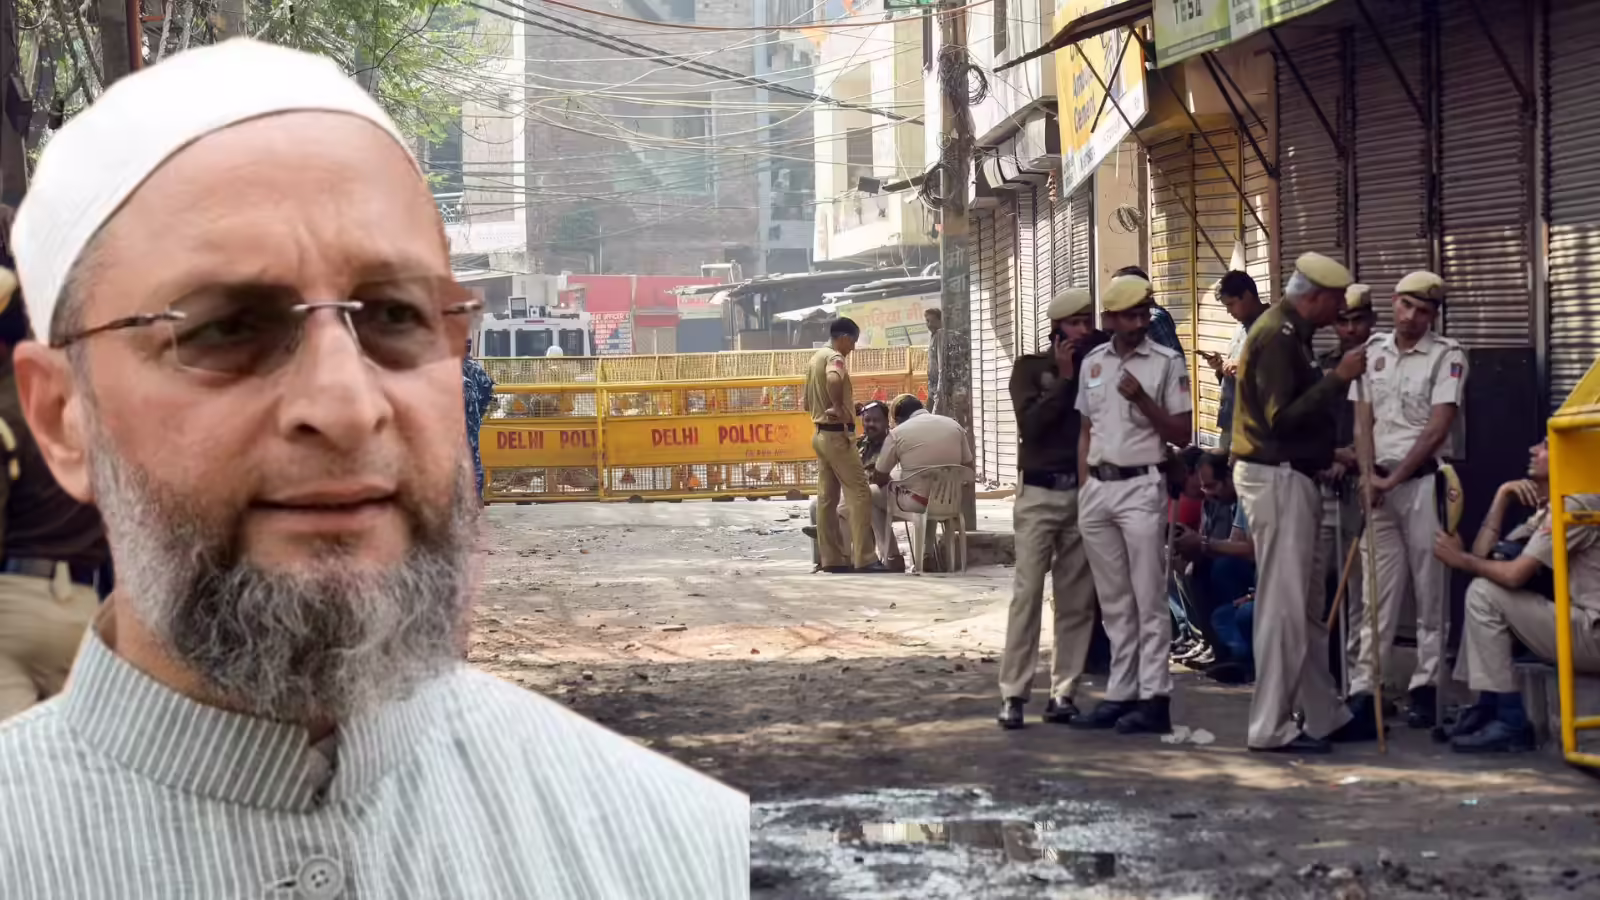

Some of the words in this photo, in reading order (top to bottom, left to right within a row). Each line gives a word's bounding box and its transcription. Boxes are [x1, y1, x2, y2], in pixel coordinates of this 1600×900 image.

[497, 430, 544, 450] DELHI
[560, 430, 600, 450] POLI
[651, 426, 699, 447] DELHI
[718, 423, 773, 445] POLICE
